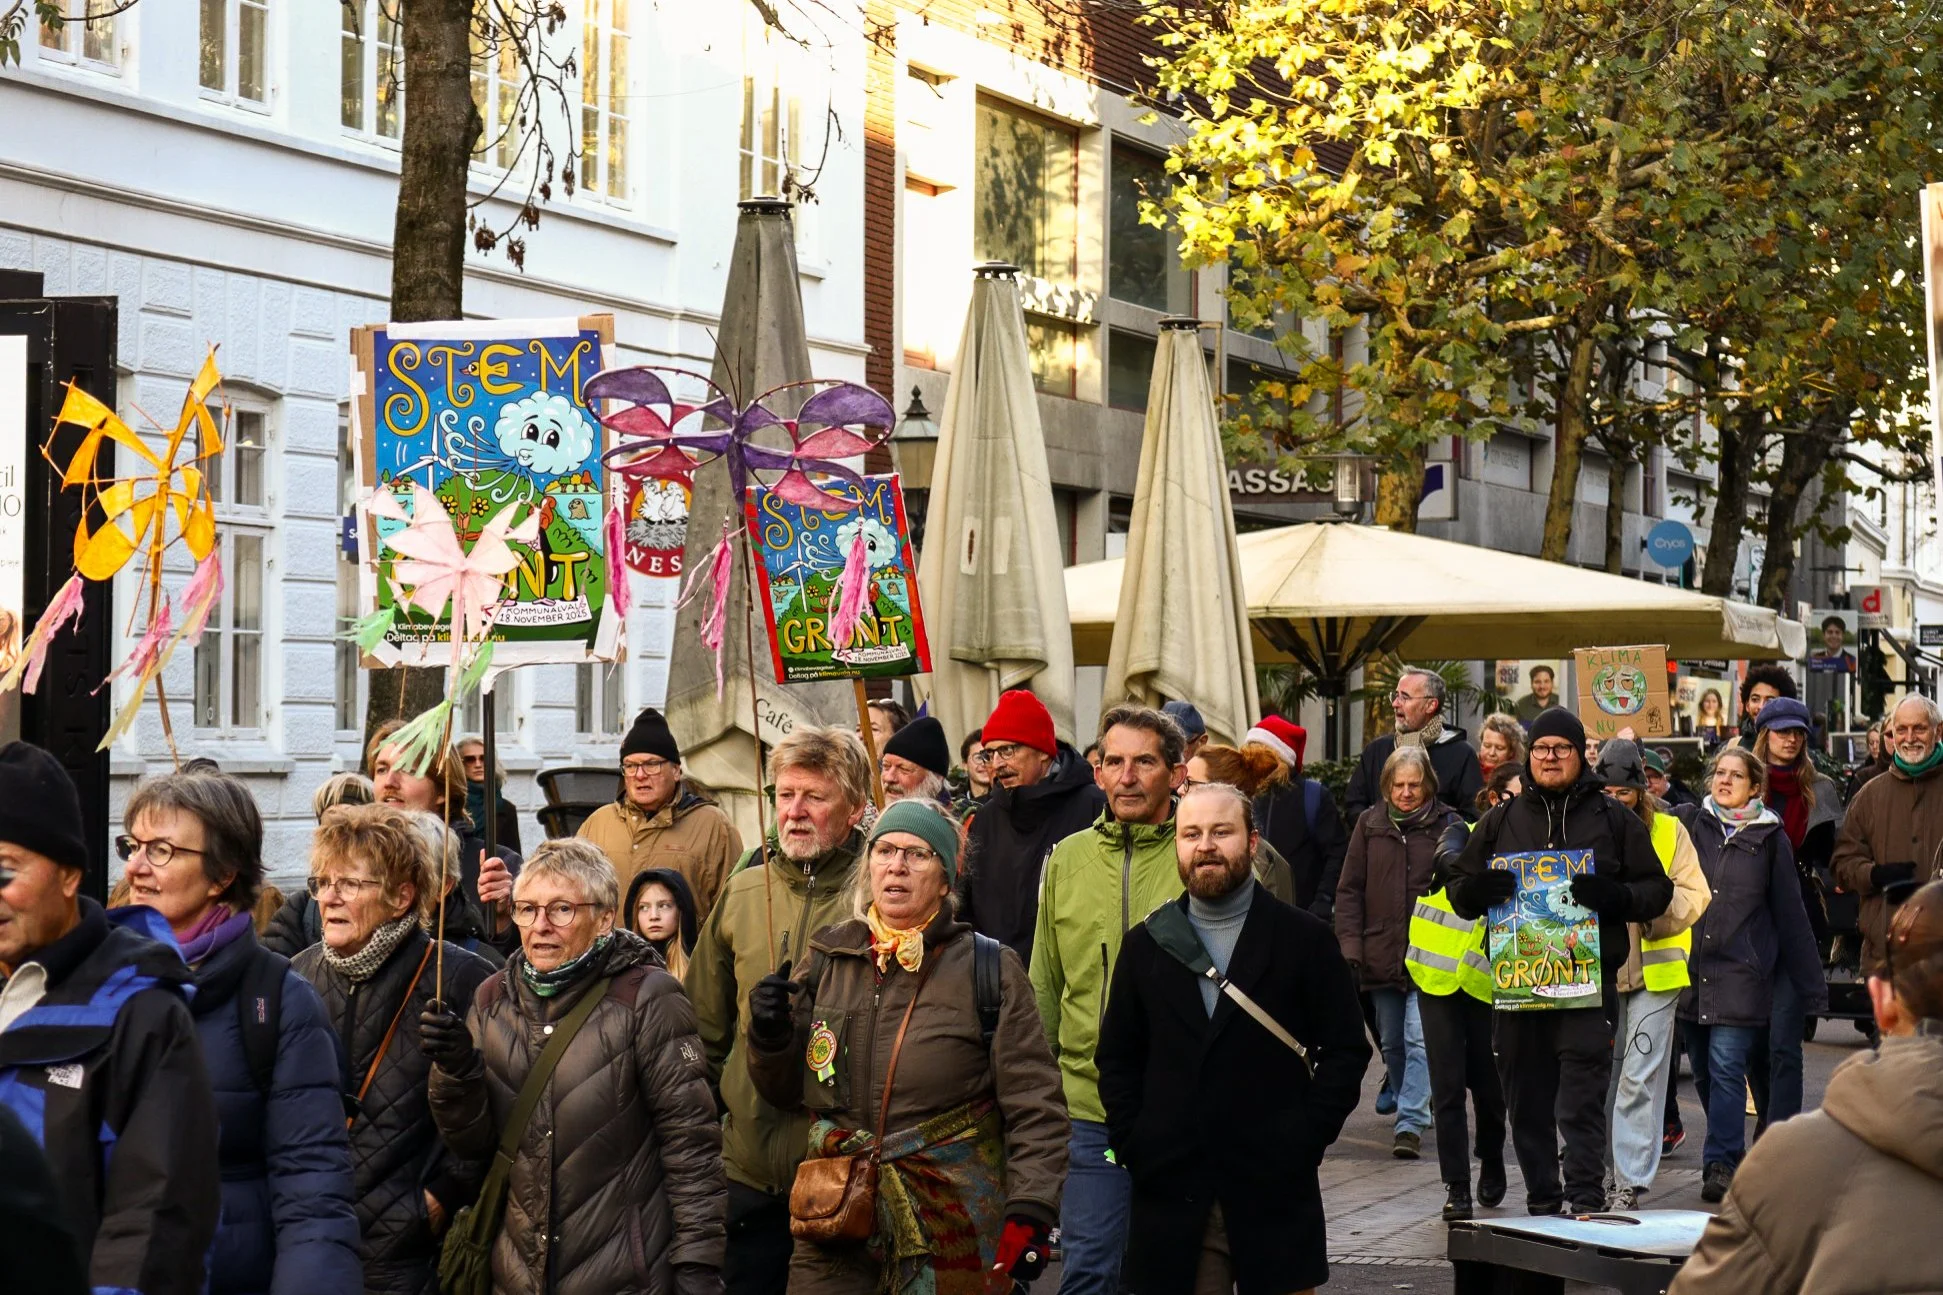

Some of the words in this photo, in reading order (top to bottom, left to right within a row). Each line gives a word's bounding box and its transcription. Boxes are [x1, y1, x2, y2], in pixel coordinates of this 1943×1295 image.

[384, 339, 591, 437] STEM
[762, 483, 892, 550] STEM
[566, 610, 588, 620] 2025
[783, 615, 903, 654] GRNT
[1587, 649, 1641, 669] KLIMA
[1596, 719, 1616, 735] NU
[1494, 957, 1595, 989] GRØNT
